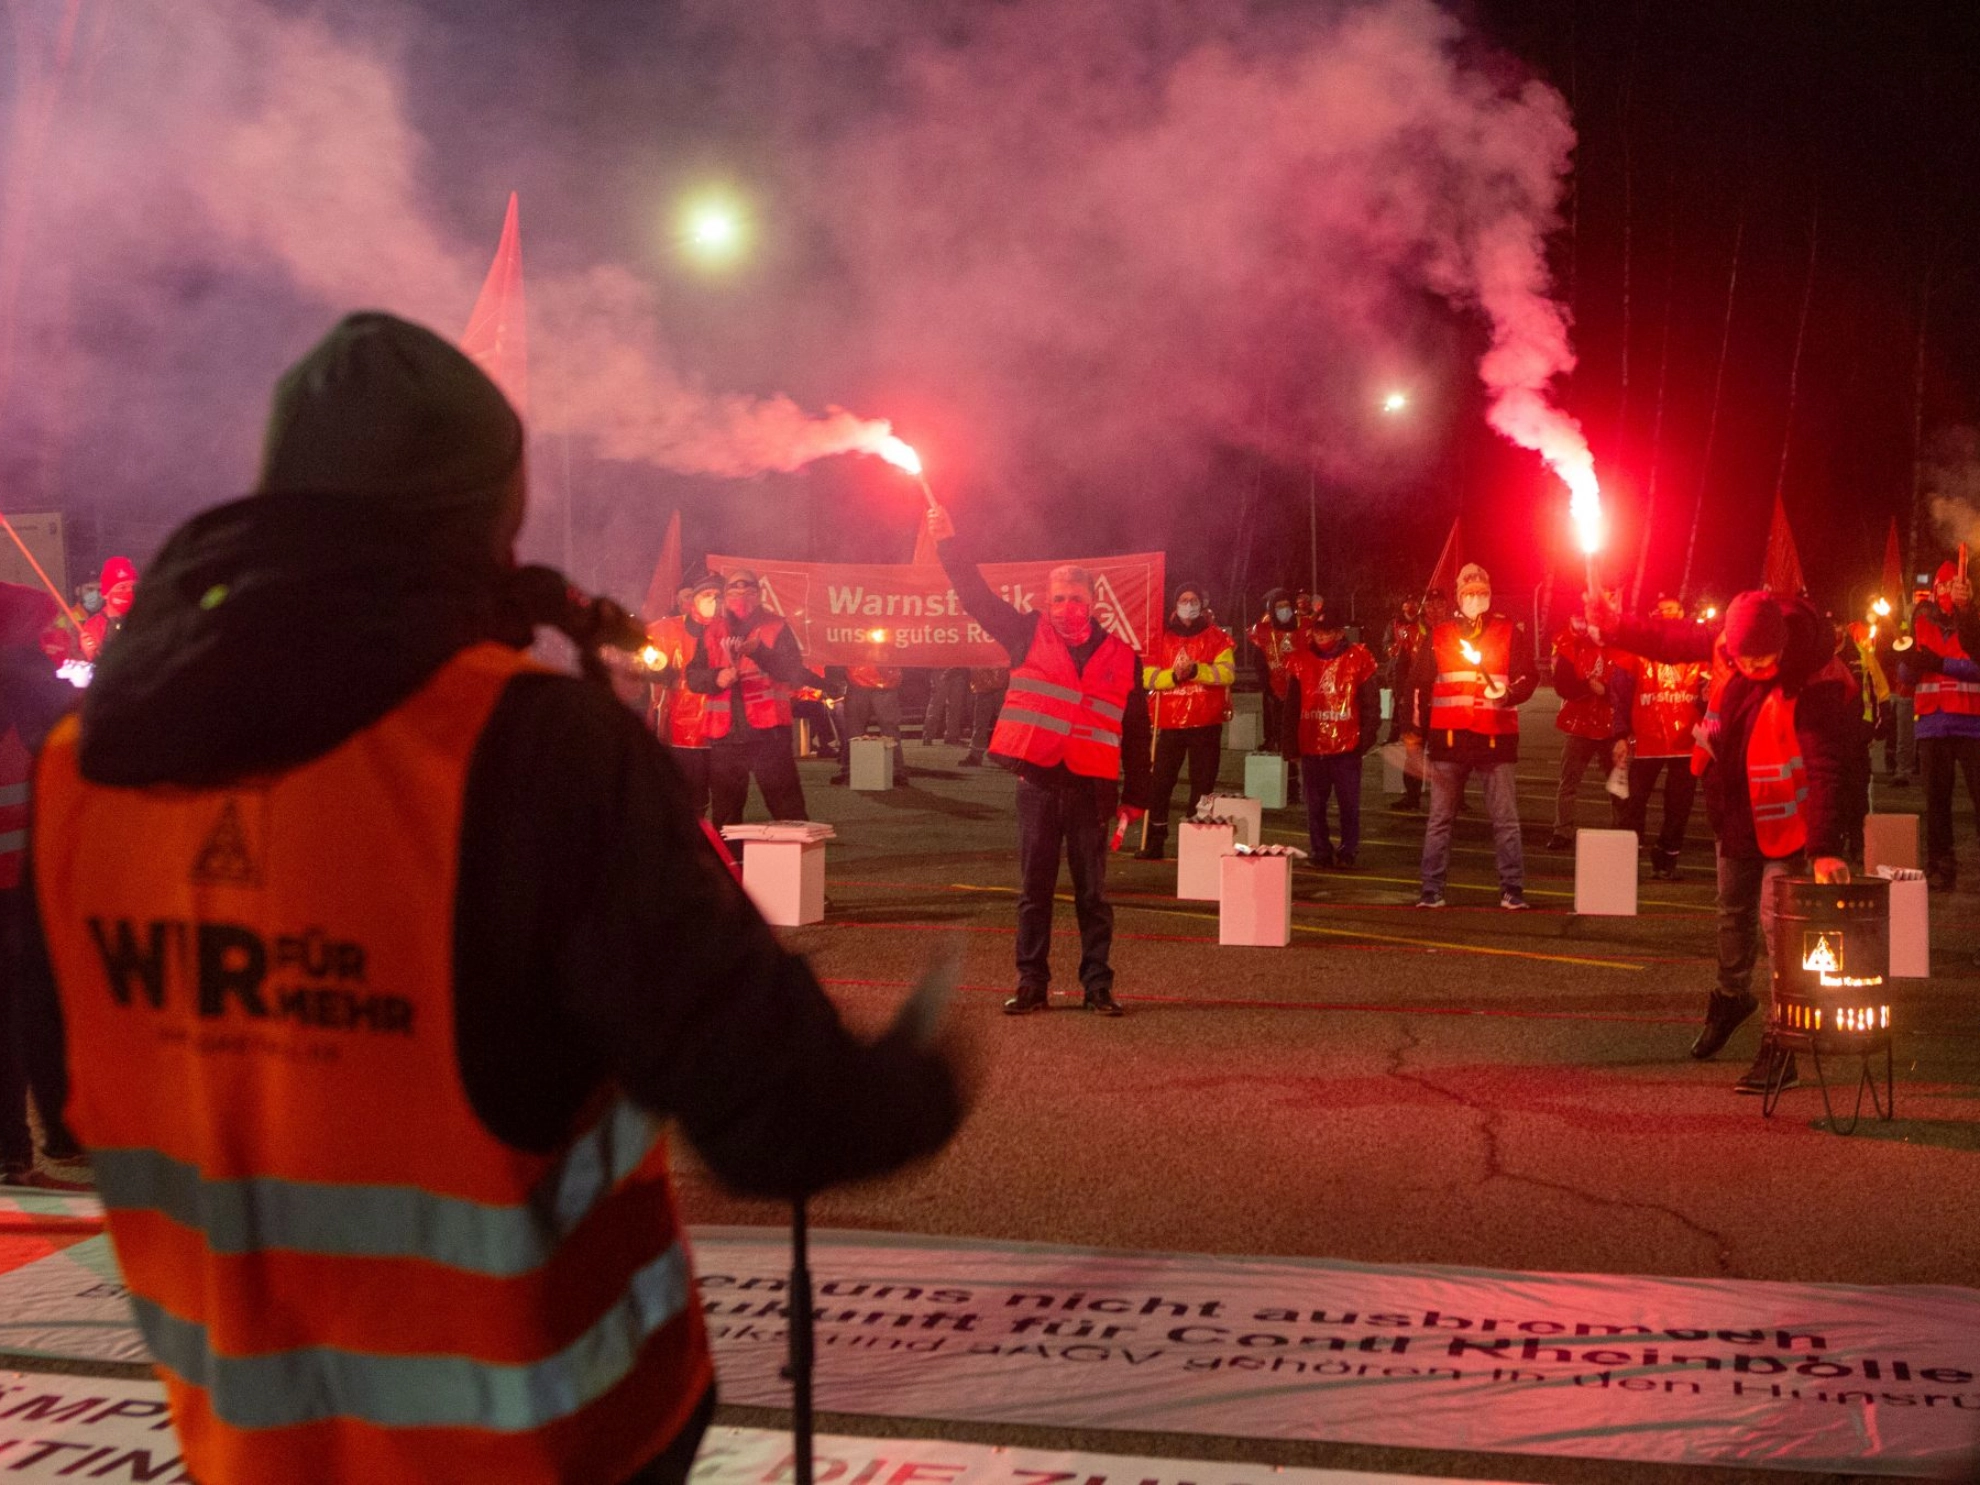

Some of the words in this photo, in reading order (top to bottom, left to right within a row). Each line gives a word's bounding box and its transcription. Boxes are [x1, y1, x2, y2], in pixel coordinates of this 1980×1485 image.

[828, 584, 1034, 616] Warnstik
[827, 627, 890, 643] uns
[895, 625, 959, 648] gutes
[967, 622, 996, 643] Re
[820, 1282, 974, 1303] uns
[1005, 1292, 1225, 1318] nicht
[702, 1301, 980, 1332] ukunft
[1010, 1315, 1137, 1339] für
[1167, 1325, 1411, 1354] Conti
[1448, 1335, 1974, 1384] Rheinbölle
[1573, 1370, 1701, 1394] den
